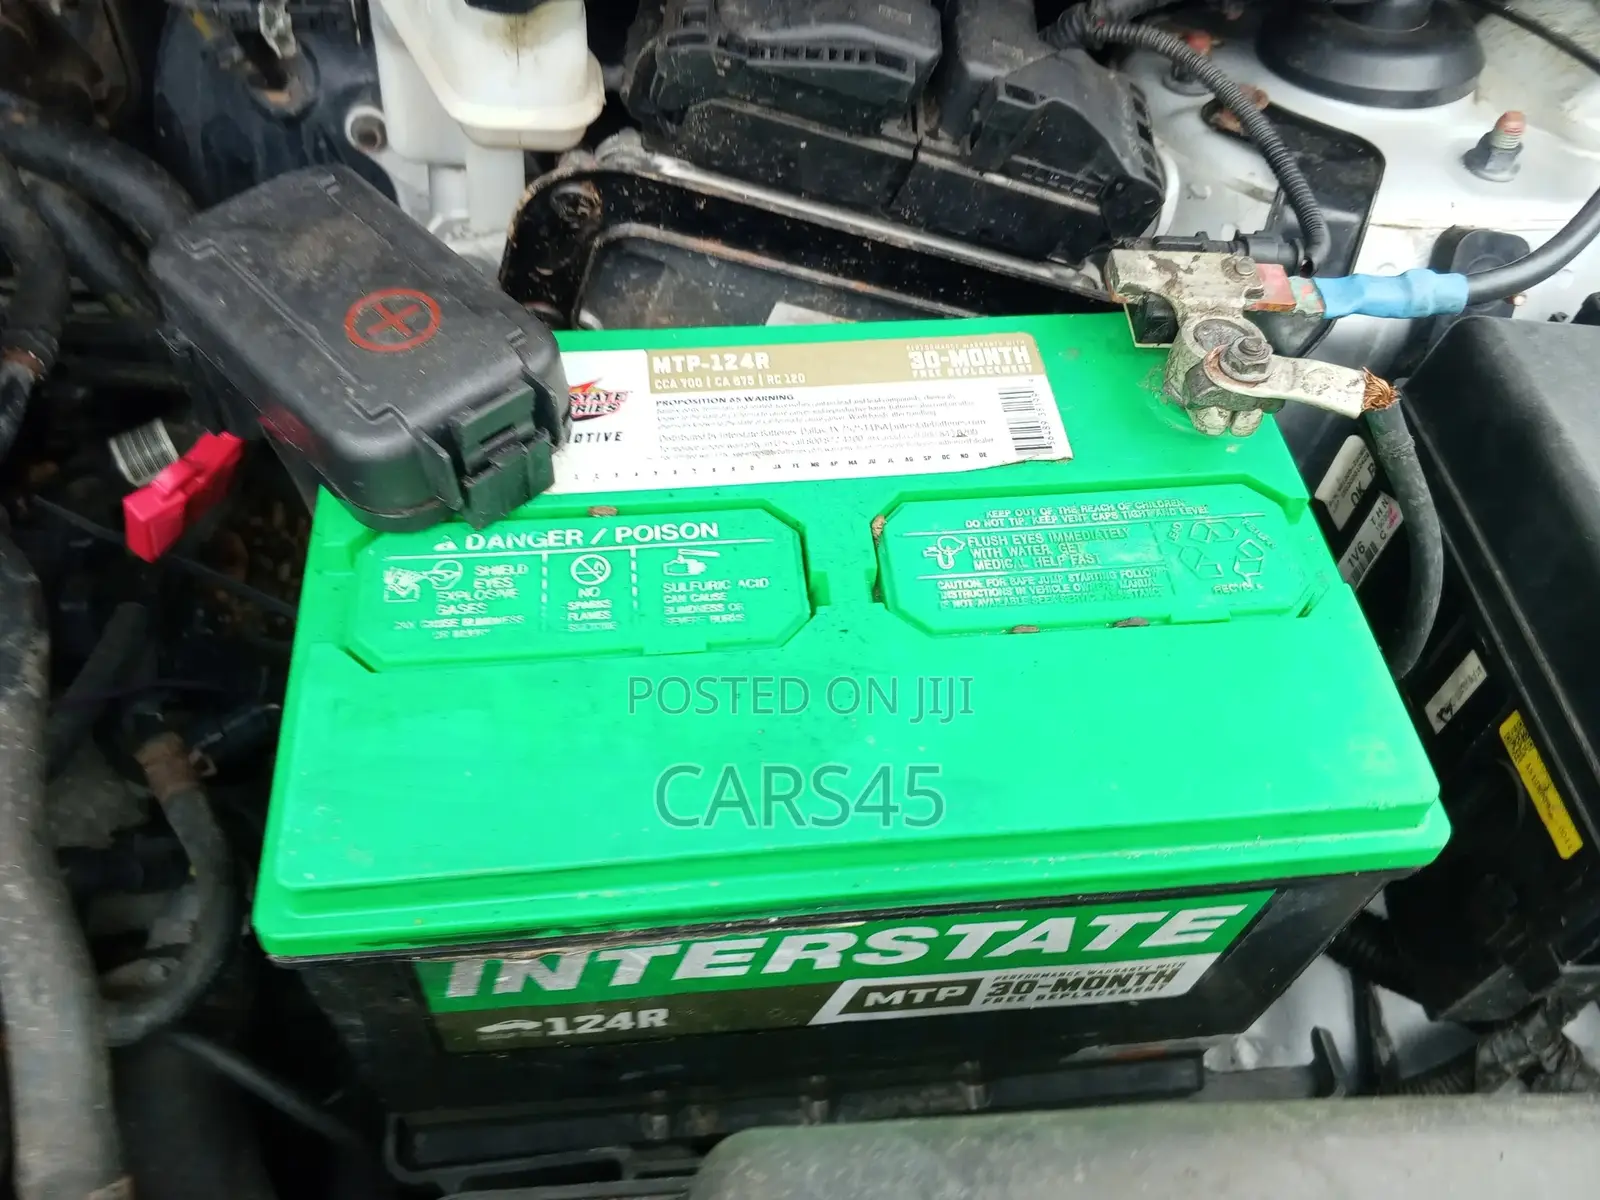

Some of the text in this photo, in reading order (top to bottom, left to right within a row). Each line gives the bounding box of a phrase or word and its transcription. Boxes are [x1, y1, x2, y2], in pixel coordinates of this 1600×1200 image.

[652, 352, 771, 374] MTP-124R
[908, 346, 1032, 371] 30-MONTH
[911, 364, 1033, 379] FREE REPLACEMENT
[654, 378, 678, 390] CCA
[714, 376, 731, 387] CA
[767, 373, 782, 385] RC
[784, 372, 806, 384] 120
[656, 396, 727, 408] PROPOSITION
[743, 393, 795, 404] WARNING
[568, 431, 624, 443] OTIVE
[1350, 482, 1367, 506] OK
[965, 519, 980, 528] DO
[984, 517, 1006, 527] NOT
[1032, 514, 1057, 525] KEEP
[1060, 512, 1088, 523] VENT
[1092, 510, 1119, 521] CAPS
[1122, 507, 1153, 519] TIGHT
[1153, 506, 1177, 517] AND
[986, 509, 1011, 519] KEEP
[1015, 508, 1035, 517] OUT
[1039, 506, 1053, 516] OF
[1057, 505, 1078, 515] THE
[1081, 503, 1114, 514] REACH
[1117, 501, 1134, 511] OF
[465, 522, 719, 550] DANGER / POISON
[967, 527, 1130, 547] FLUSH EYES IMMEDIATELY
[970, 547, 1001, 560] WITH
[1057, 541, 1082, 555] GET
[1347, 541, 1366, 569] 1V6
[474, 563, 529, 577] SHIELD
[973, 557, 1029, 572] MEDICAL
[1033, 555, 1064, 568] HELP
[473, 576, 514, 591] EYES
[662, 577, 770, 593] SULFURIC ACID
[986, 577, 1008, 588] FOR
[1010, 575, 1035, 586] SAFE
[1067, 570, 1117, 583] STARTING
[578, 586, 601, 599] NO
[663, 592, 728, 604] CAN CAUSE
[940, 587, 1012, 600] INSTRUCTIONS
[1031, 584, 1070, 596] VEHICLE
[436, 602, 489, 616] GASES
[663, 603, 725, 615] BLINDNESS
[952, 599, 975, 609] NOT
[446, 903, 1248, 998] INTERSTATE
[994, 970, 1081, 983] PERFORMANCE
[1087, 964, 1151, 976] WARRANTY
[863, 967, 1183, 1008] MTP 30-MONTH
[981, 984, 1165, 1006] FREE REPLACEMENT
[544, 1008, 670, 1037] 124R
